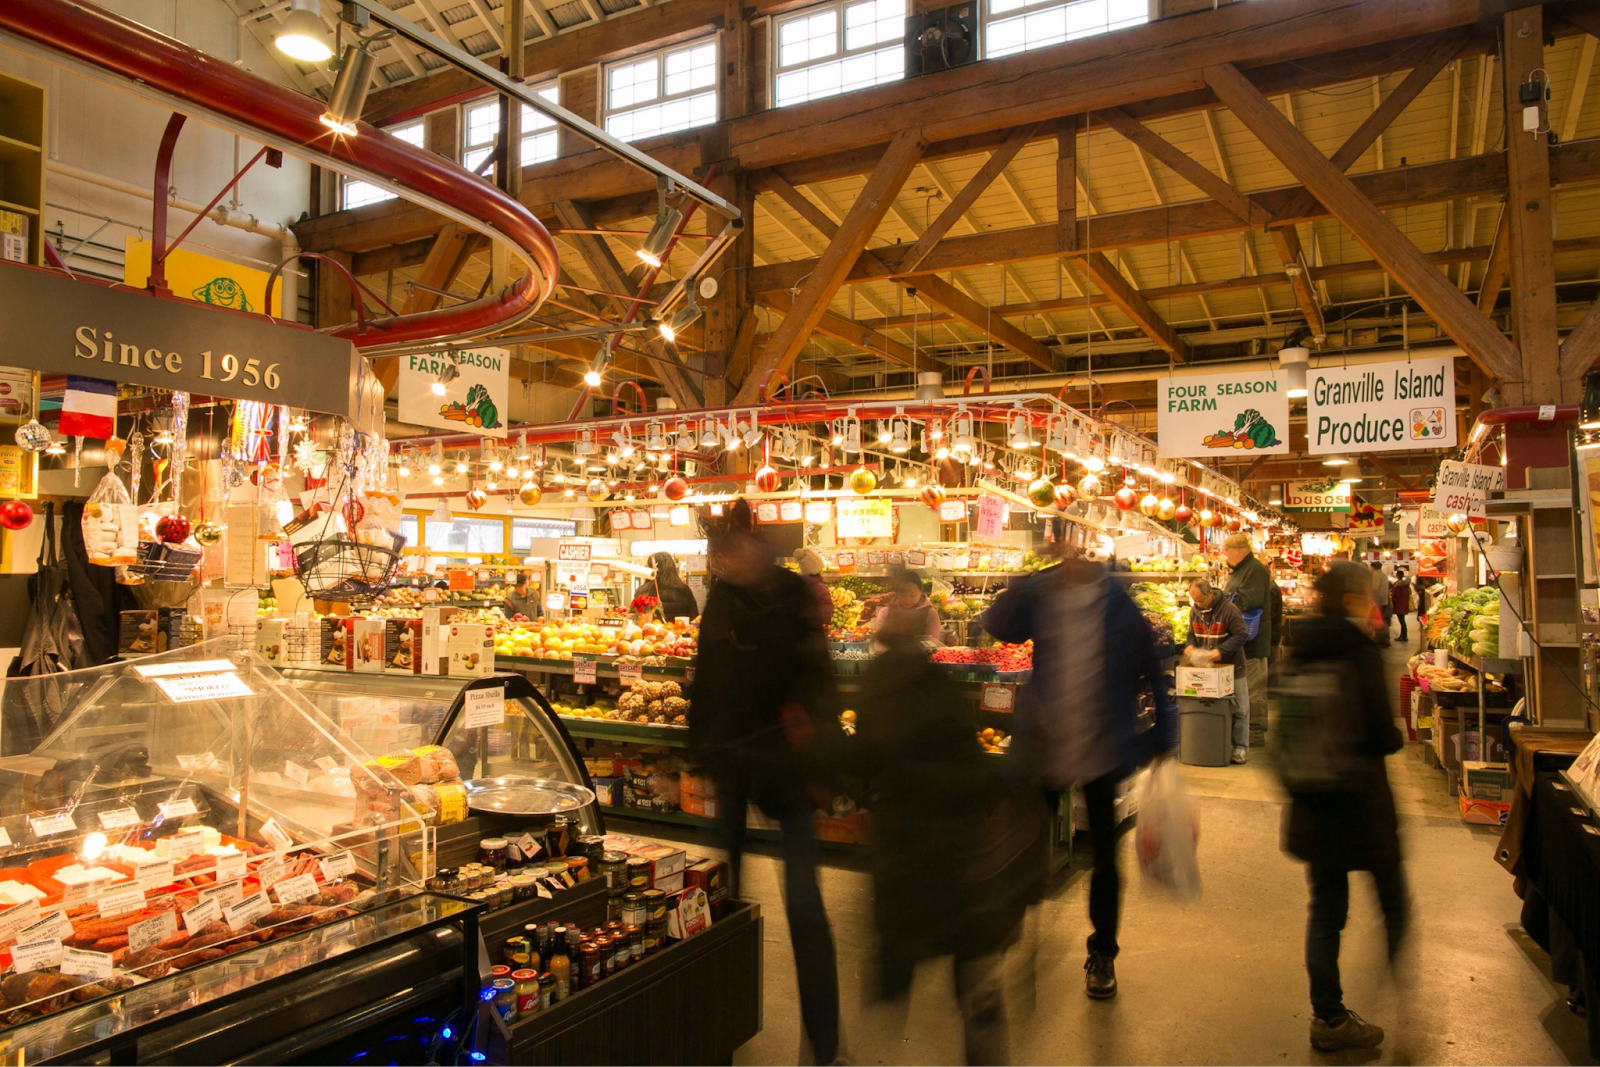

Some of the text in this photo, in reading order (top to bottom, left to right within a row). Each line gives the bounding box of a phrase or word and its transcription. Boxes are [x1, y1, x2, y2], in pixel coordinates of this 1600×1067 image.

[75, 326, 281, 390] Since 1956
[460, 350, 501, 371] EASON
[1168, 380, 1277, 399] FOUR SEASON
[1314, 365, 1445, 407] Granville Island
[1168, 398, 1218, 413] FARM
[1316, 412, 1404, 446] Produce
[1441, 465, 1470, 487] Granville
[1470, 468, 1494, 490] Island
[1292, 495, 1344, 505] DUSOS
[560, 545, 590, 560] CASHIER
[485, 690, 500, 698] Shells
